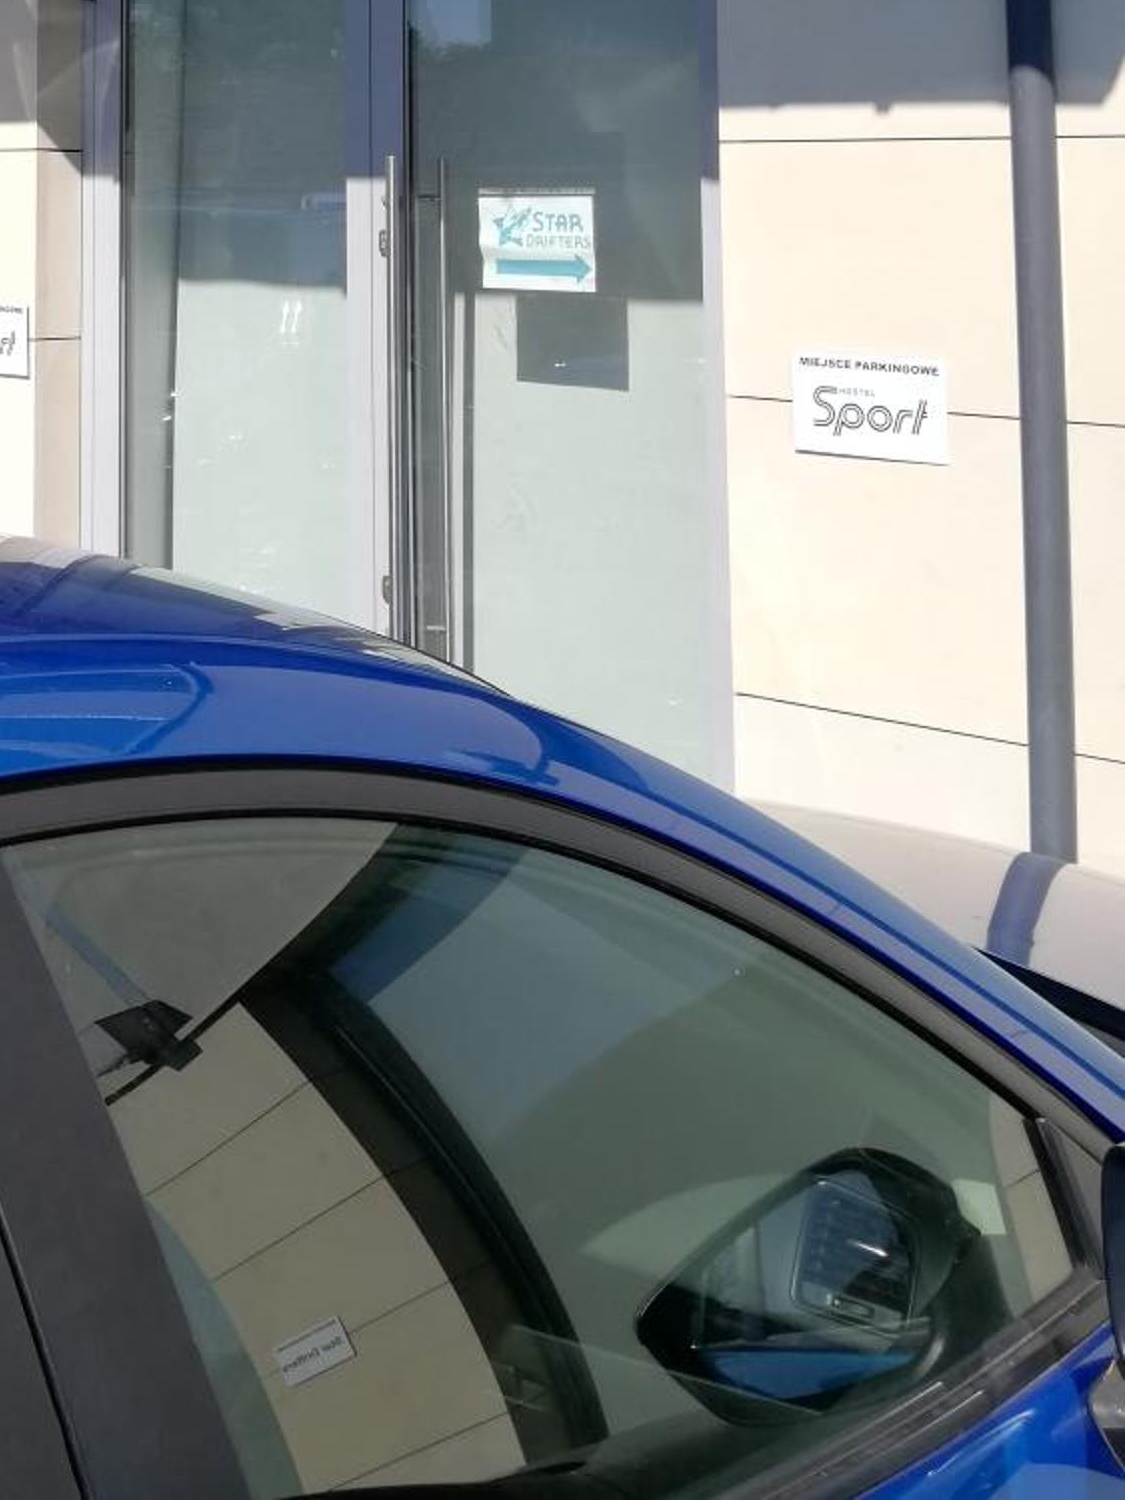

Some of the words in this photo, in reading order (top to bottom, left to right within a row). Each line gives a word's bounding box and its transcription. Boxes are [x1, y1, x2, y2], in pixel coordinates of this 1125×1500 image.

[532, 211, 584, 233] STAR
[799, 357, 851, 369] MIEJSCE
[855, 360, 939, 377] PARKINGOWE
[813, 385, 928, 436] Sport
